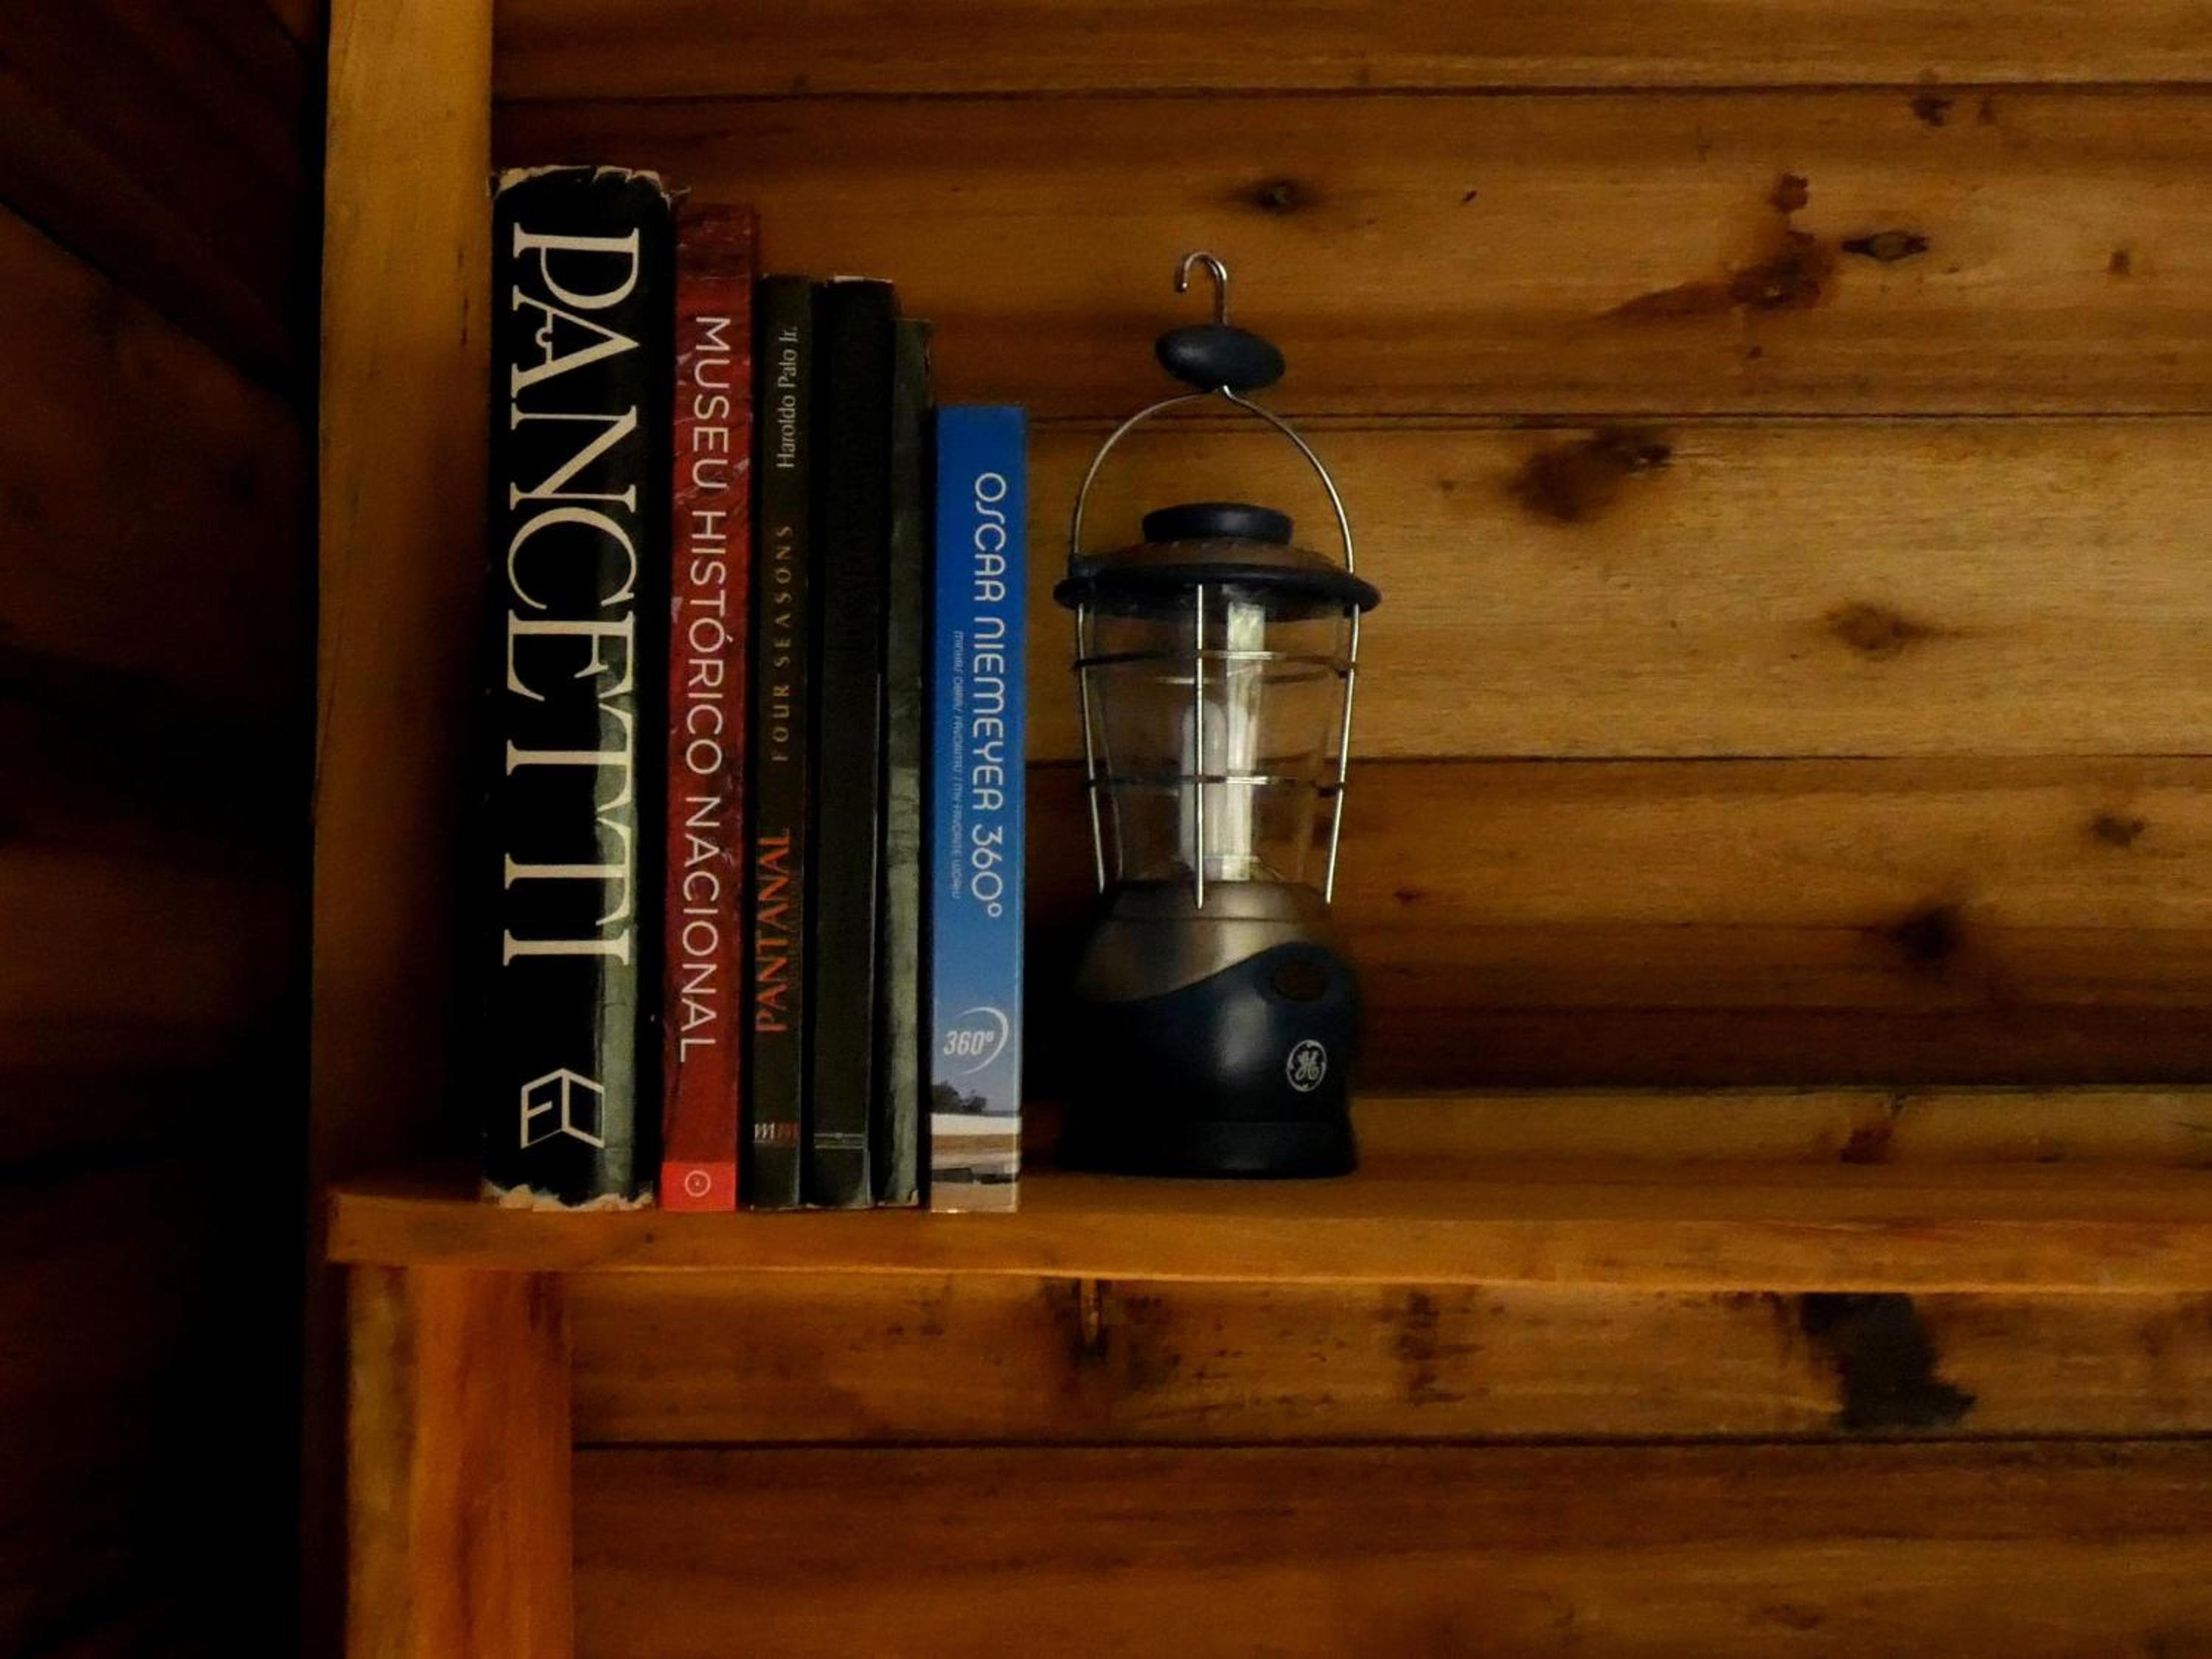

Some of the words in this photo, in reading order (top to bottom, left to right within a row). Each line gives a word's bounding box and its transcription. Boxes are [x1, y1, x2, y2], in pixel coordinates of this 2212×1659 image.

[691, 315, 732, 490] MUSEU
[776, 394, 797, 469] Haroldo
[777, 348, 798, 389] Palo
[501, 222, 640, 967] PANCETTI
[774, 524, 792, 667] SEASONS
[973, 471, 1007, 602] OSCAR
[685, 509, 734, 775] HISTÓRICO
[771, 684, 790, 762] FOUR
[971, 616, 1006, 811] NIEMEYER
[680, 796, 722, 1063] NACIONAL
[754, 825, 791, 1032] PANTANAL
